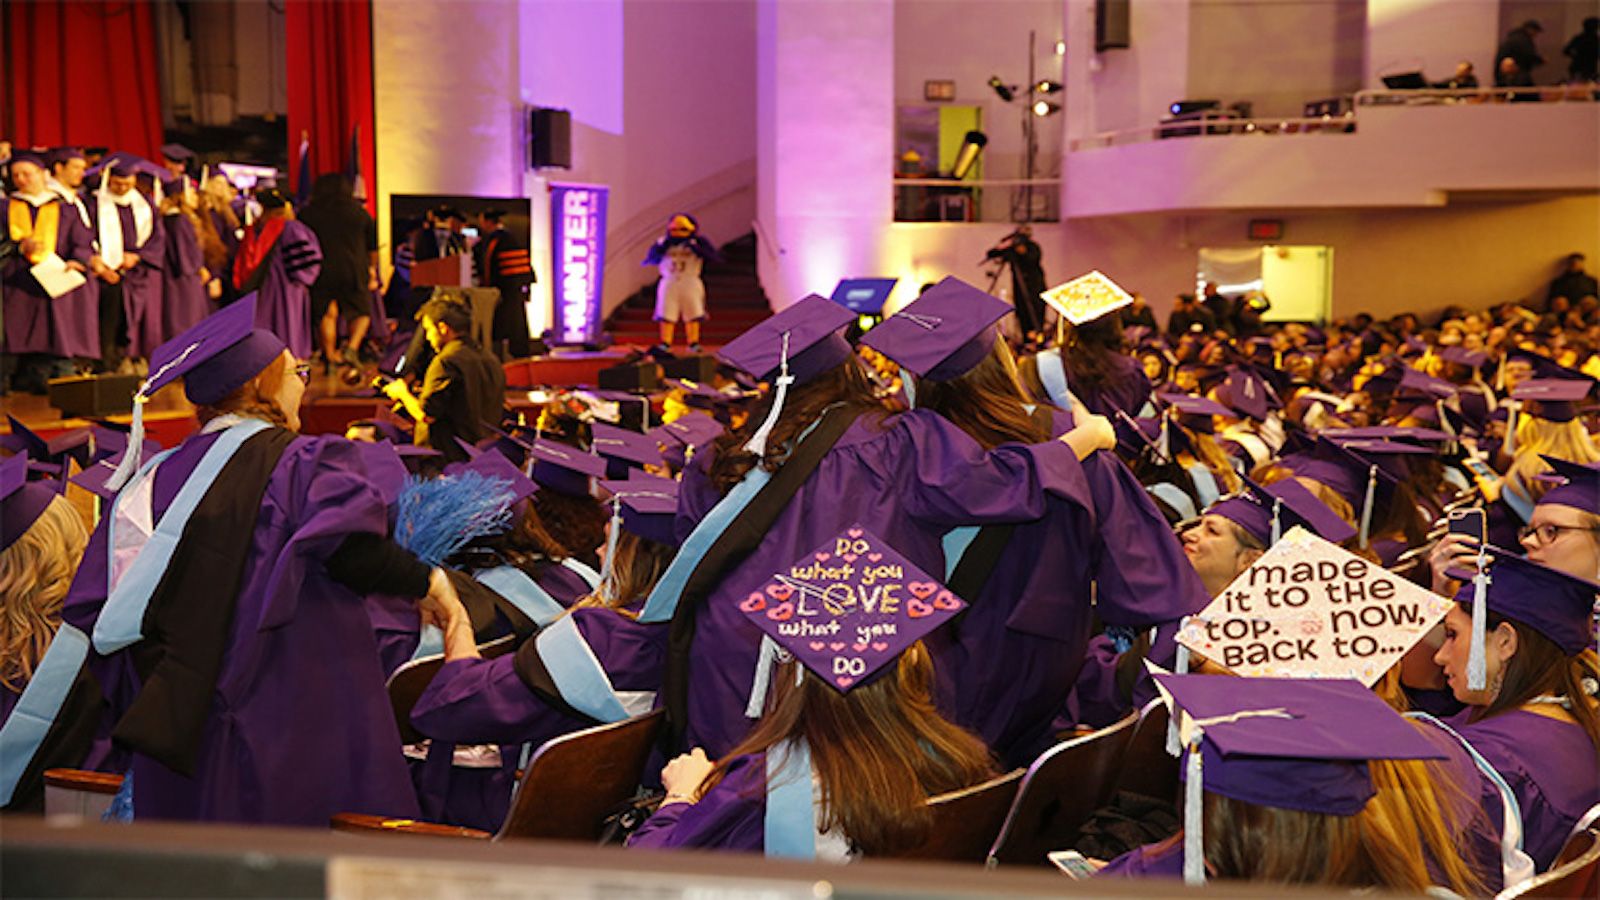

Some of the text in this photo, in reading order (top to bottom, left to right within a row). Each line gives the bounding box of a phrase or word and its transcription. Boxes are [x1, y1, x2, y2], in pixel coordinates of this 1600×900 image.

[563, 189, 591, 343] HUNTER
[835, 538, 870, 557] DO
[791, 561, 903, 585] what you
[797, 583, 902, 616] LOVE
[1225, 591, 1252, 612] it
[778, 619, 897, 645] what you
[832, 656, 866, 676] DO
